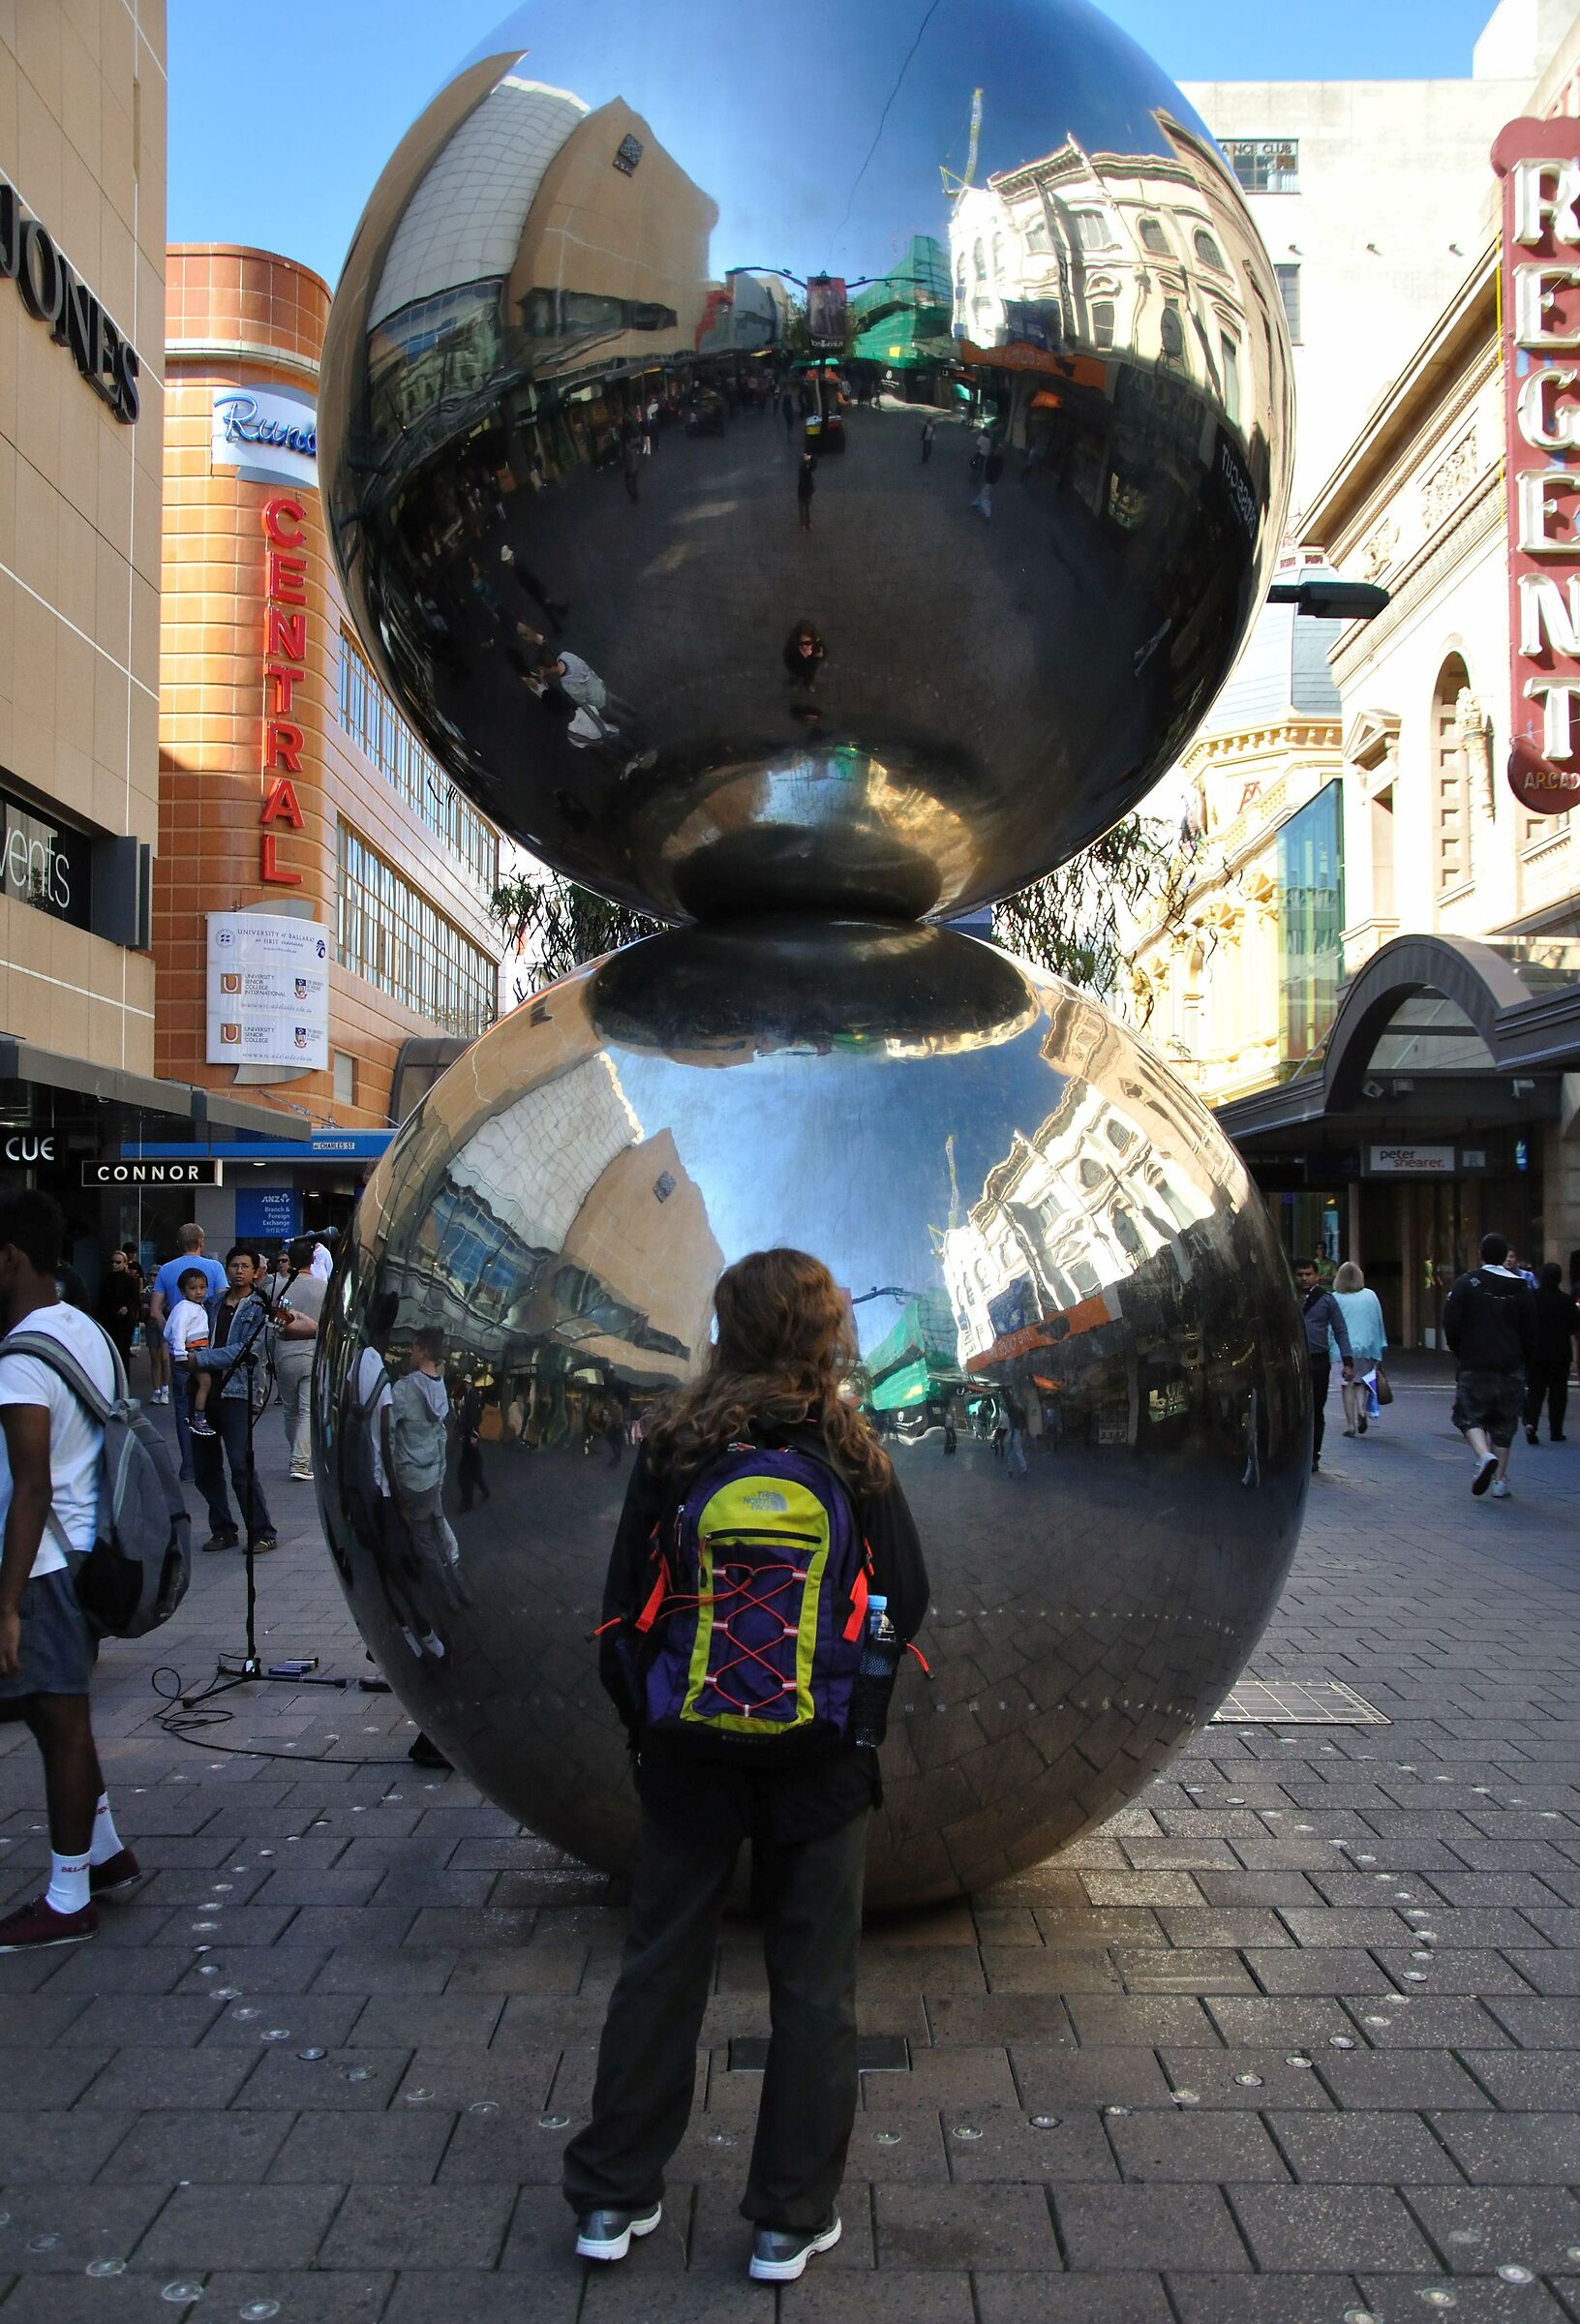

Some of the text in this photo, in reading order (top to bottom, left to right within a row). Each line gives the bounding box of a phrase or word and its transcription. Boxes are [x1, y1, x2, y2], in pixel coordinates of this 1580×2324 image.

[1262, 143, 1292, 155] CLUB
[0, 184, 139, 425] JONES
[1512, 155, 1580, 761] REGENT
[261, 498, 308, 886] CENTRAL
[237, 929, 280, 937] UNIVERSITY
[5, 1136, 55, 1161] CUE
[1380, 1148, 1416, 1160] peter
[1393, 1158, 1446, 1168] shearer.
[97, 1165, 199, 1181] CONNOR
